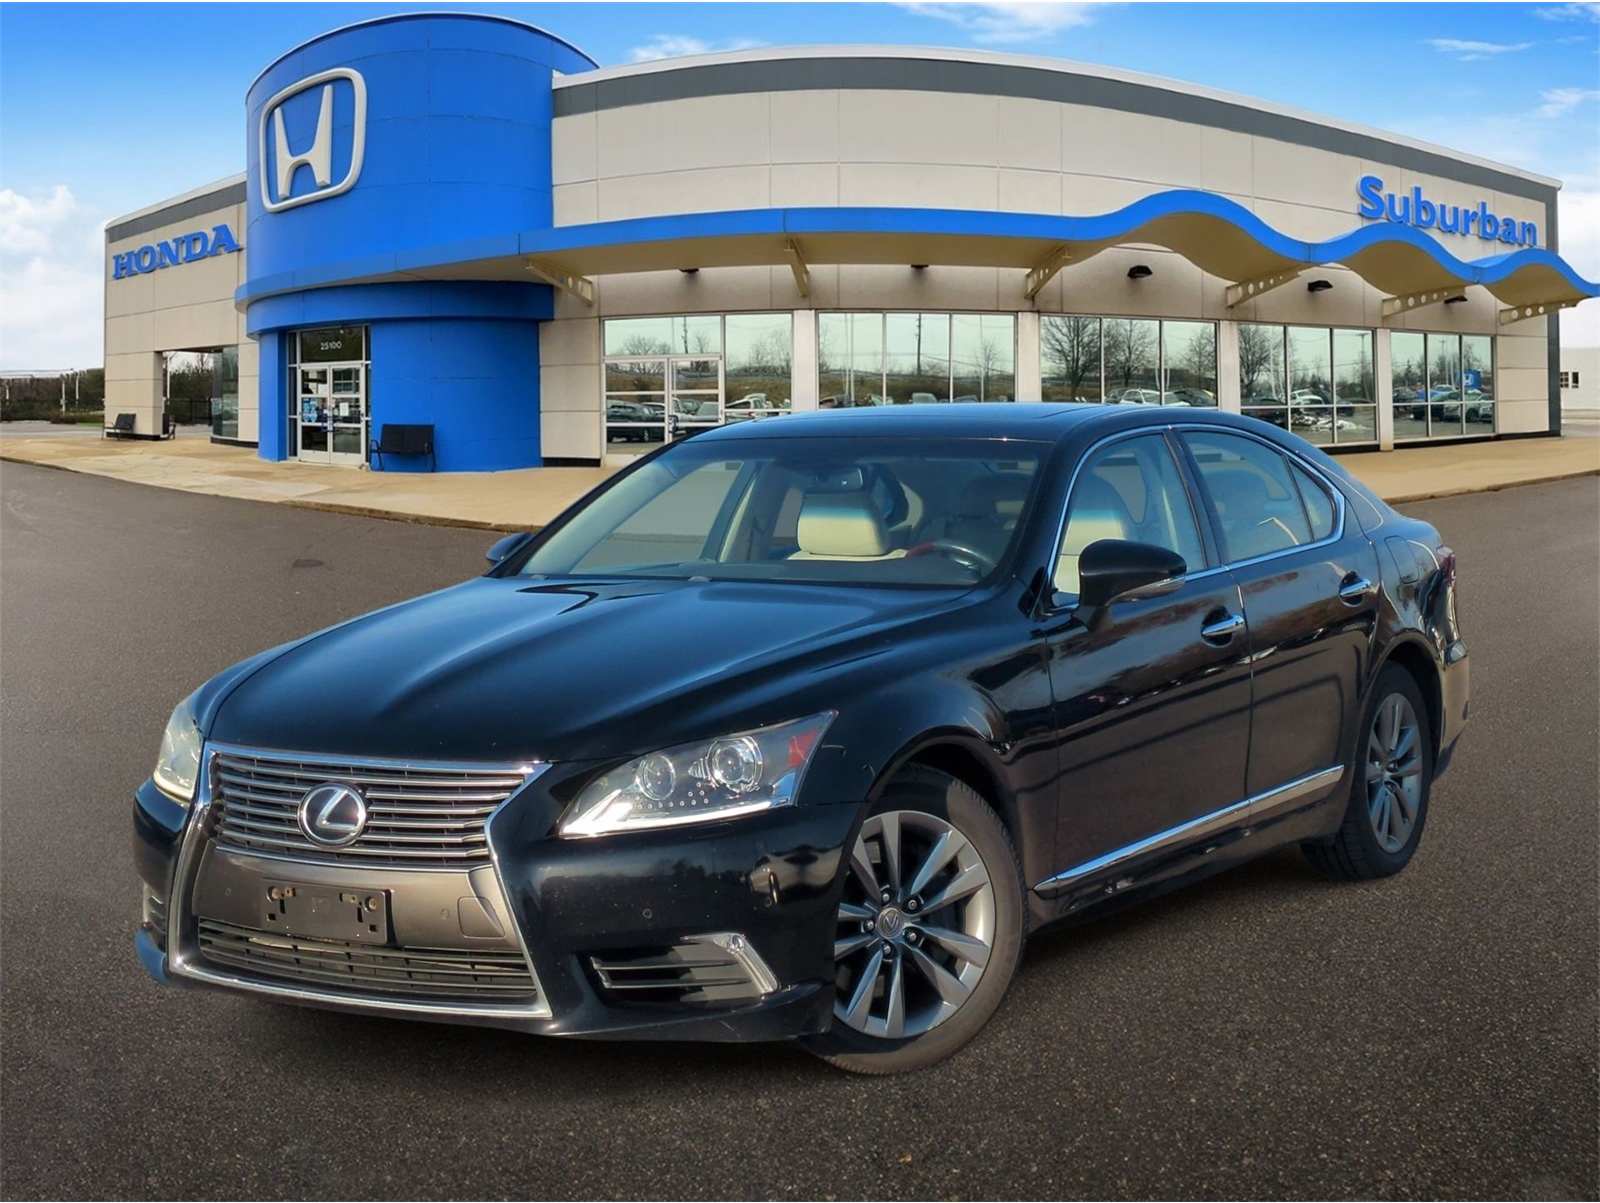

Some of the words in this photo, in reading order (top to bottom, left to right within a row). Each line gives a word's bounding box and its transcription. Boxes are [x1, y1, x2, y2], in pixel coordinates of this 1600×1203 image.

[1358, 175, 1537, 247] Suburban
[113, 224, 240, 280] HONDA
[320, 340, 342, 350] 25100
